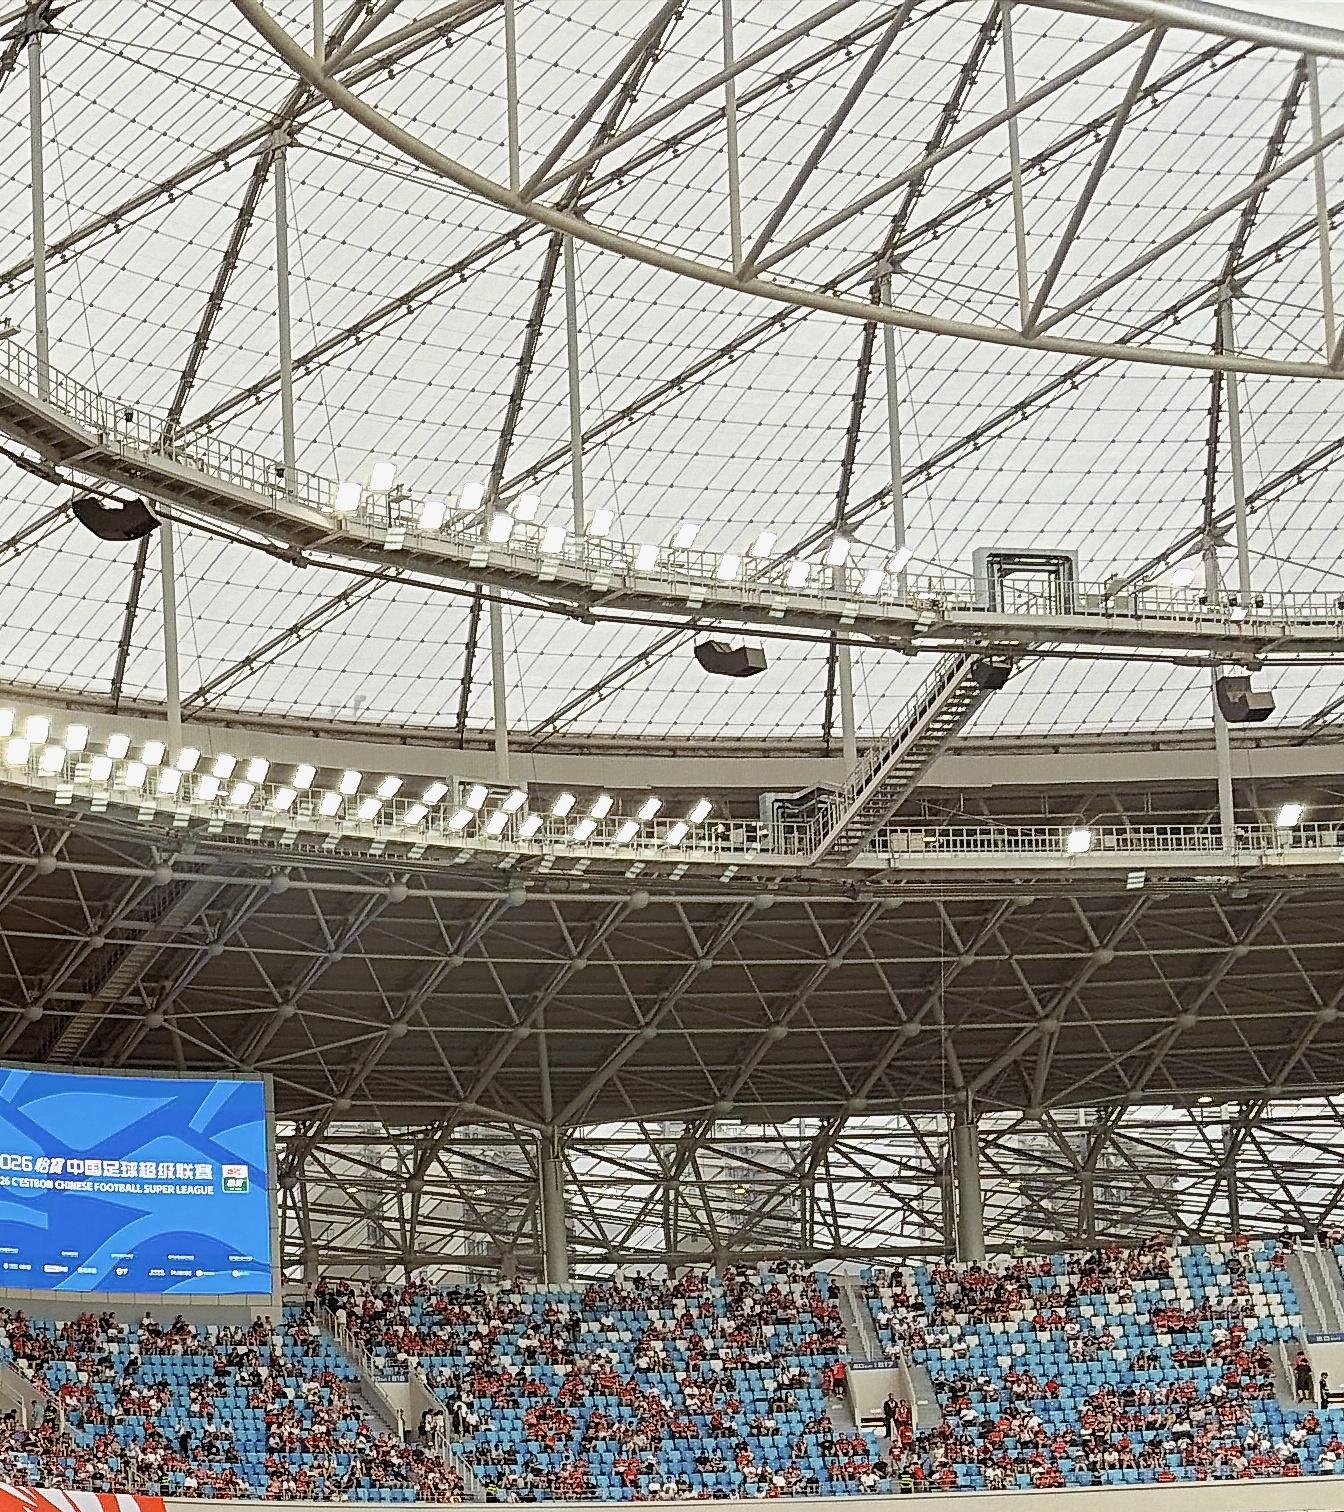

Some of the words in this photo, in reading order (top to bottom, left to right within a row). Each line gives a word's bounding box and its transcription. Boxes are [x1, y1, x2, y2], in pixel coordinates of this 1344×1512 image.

[67, 1159, 213, 1180] 中国足球超级联赛
[55, 1180, 93, 1191] CHINESE
[94, 1182, 142, 1194] FOOTBALL
[144, 1184, 175, 1195] SUPER
[176, 1185, 214, 1196] LEAGUE
